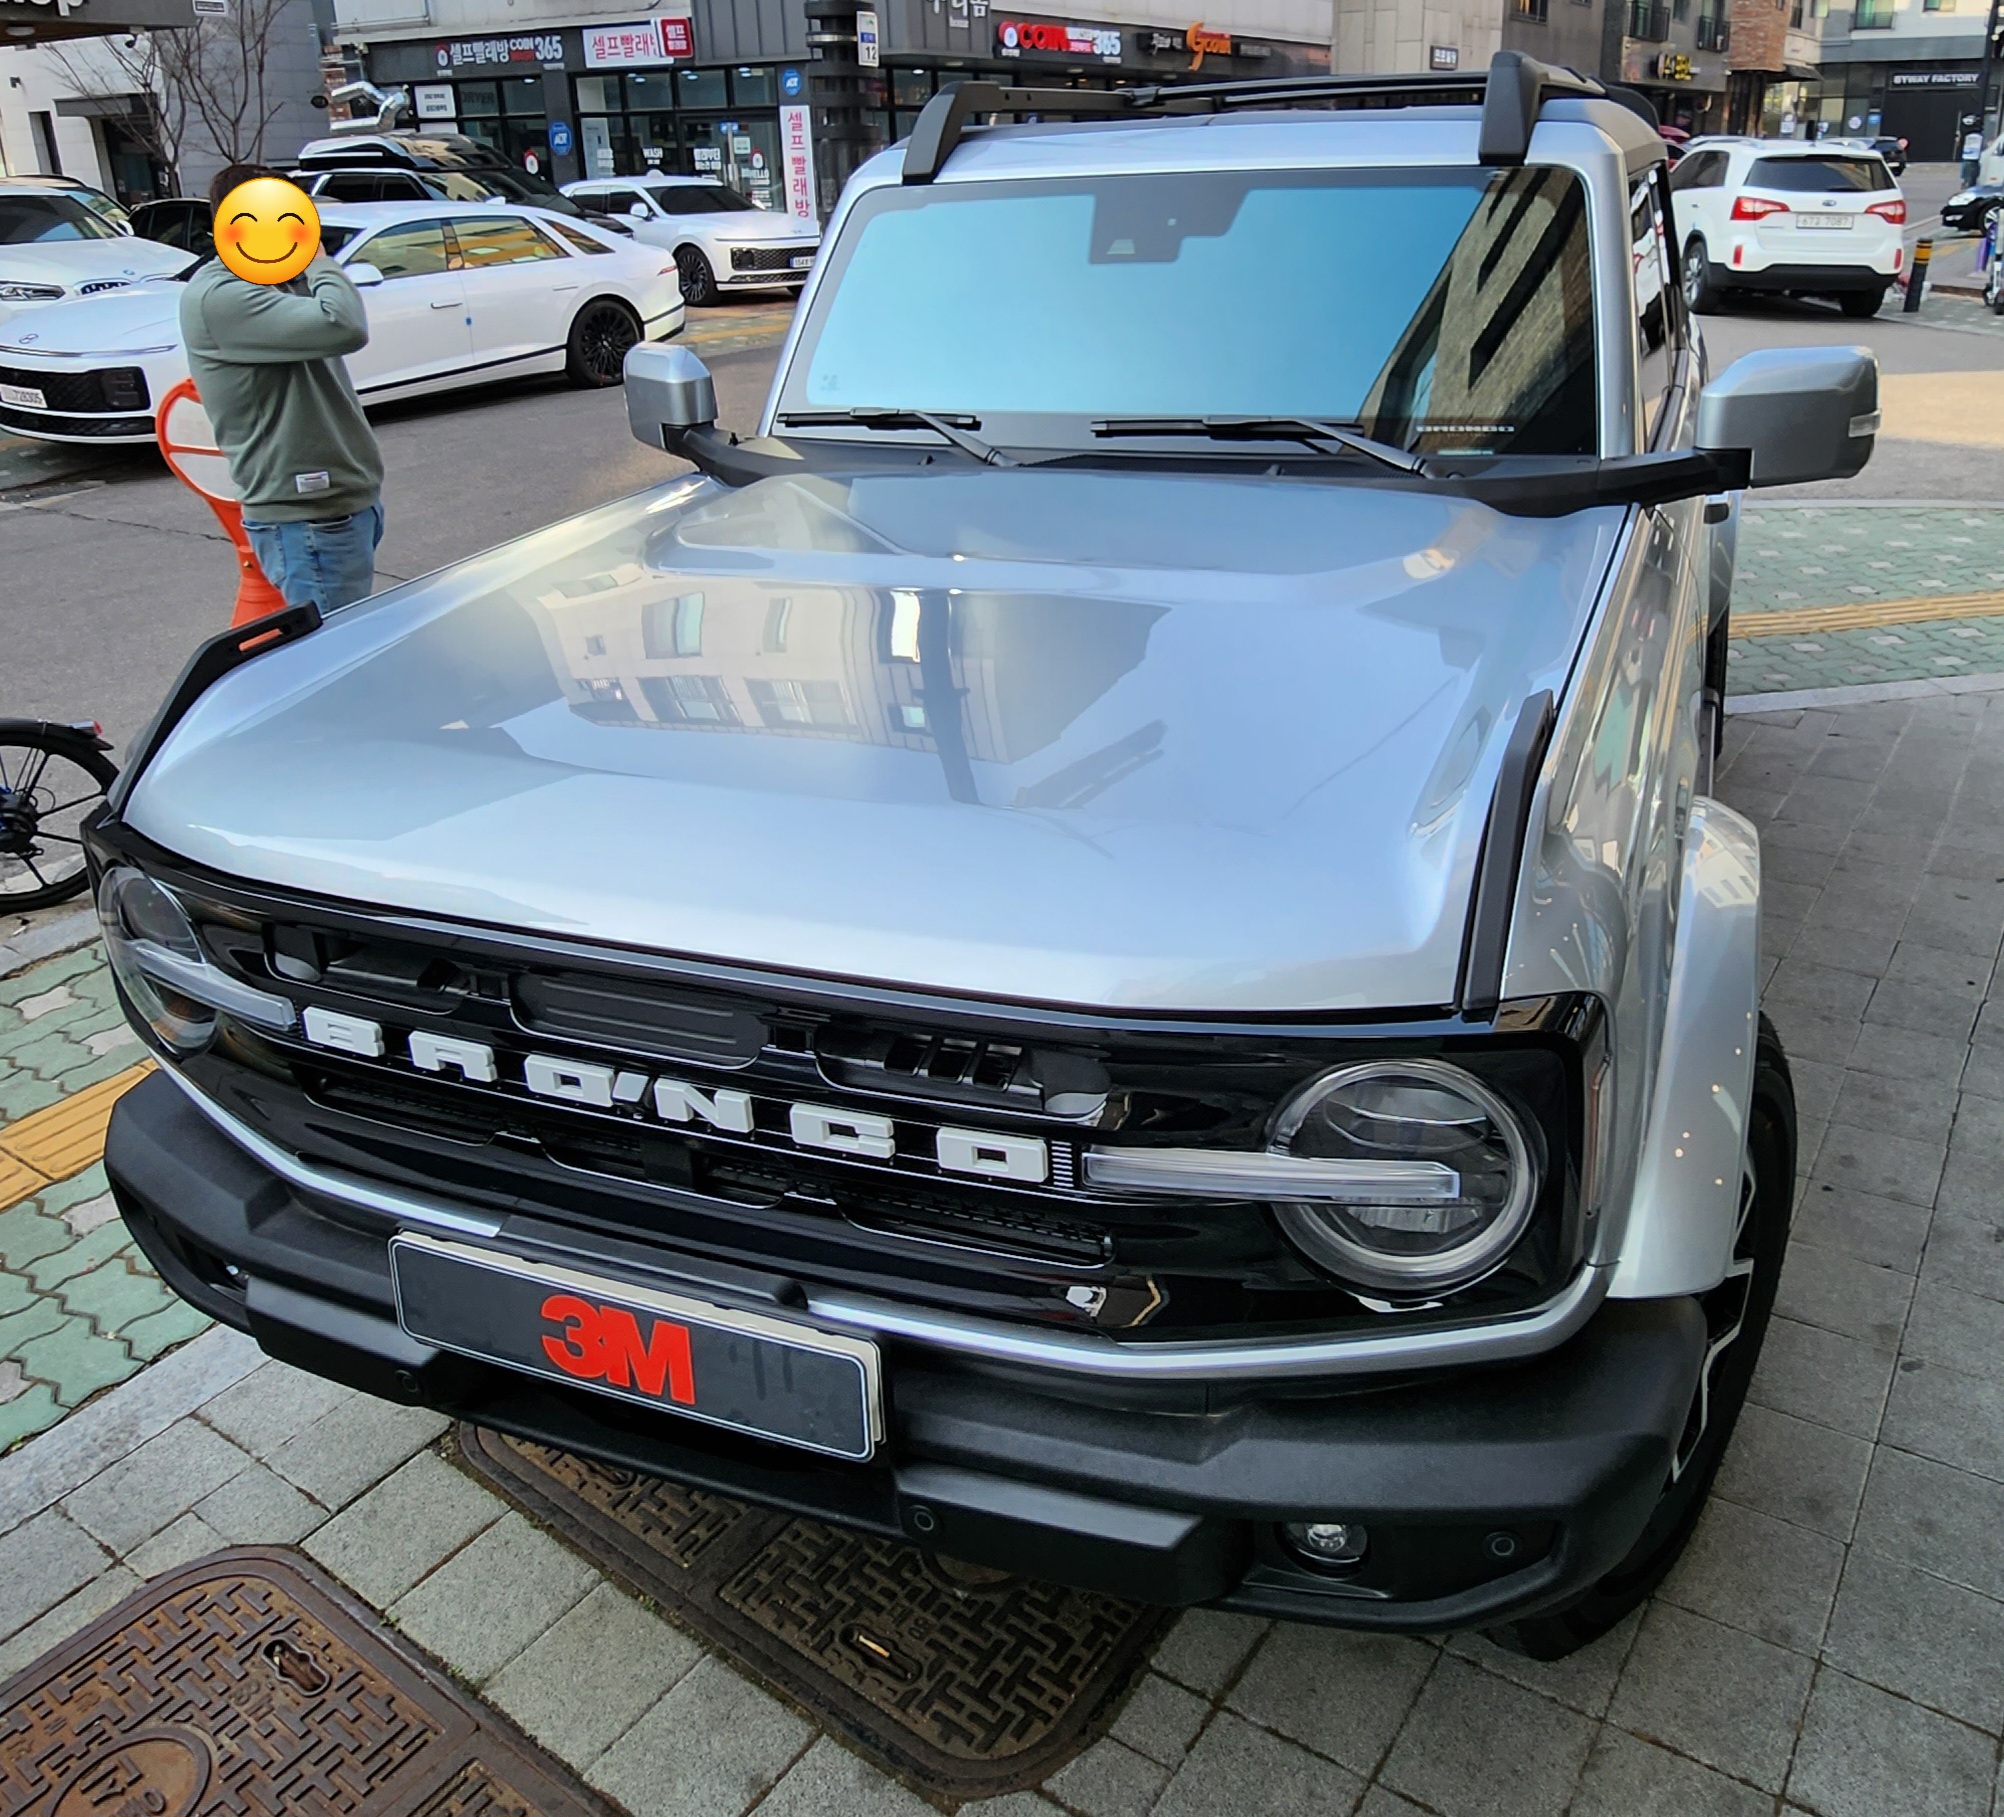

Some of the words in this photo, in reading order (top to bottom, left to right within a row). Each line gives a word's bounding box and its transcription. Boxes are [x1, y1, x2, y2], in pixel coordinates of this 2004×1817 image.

[450, 39, 509, 66] 셀프빨래방
[534, 35, 563, 60] 365
[1017, 23, 1069, 51] COIN
[1093, 30, 1121, 55] 365
[1931, 73, 1979, 82] FACTORY
[788, 111, 810, 218] 셀프빨래방
[303, 1005, 1049, 1183] BRONCO
